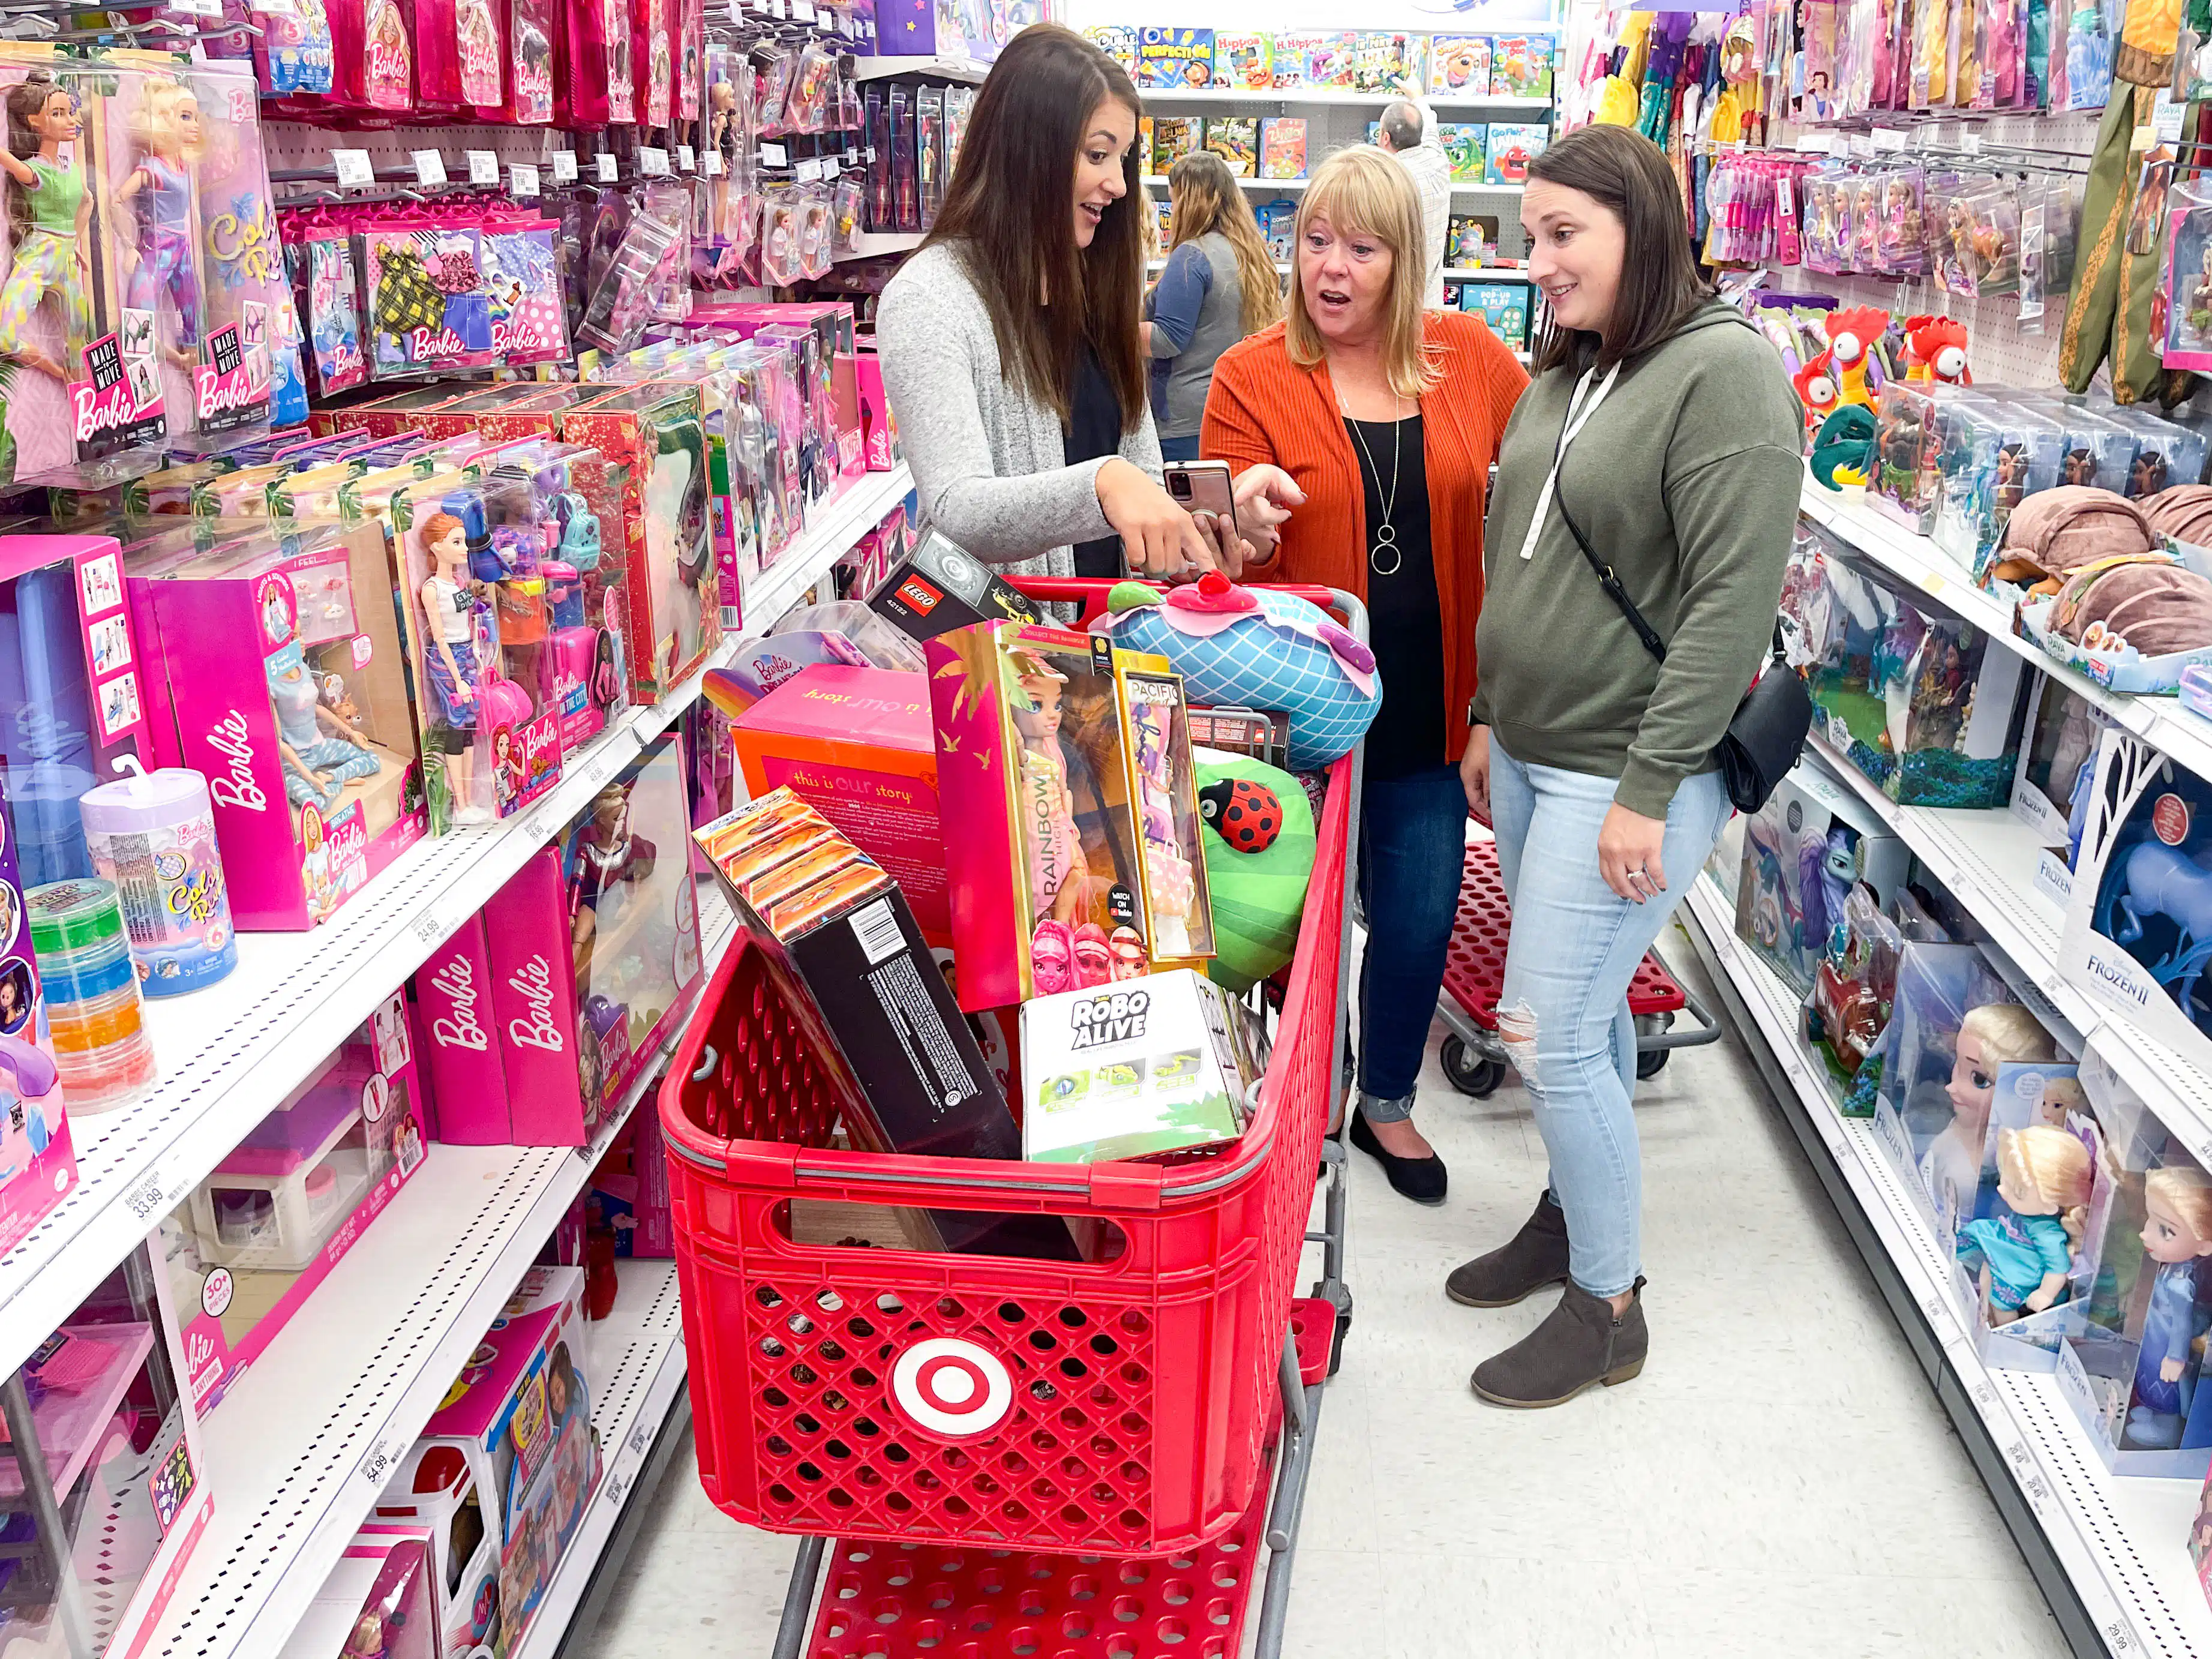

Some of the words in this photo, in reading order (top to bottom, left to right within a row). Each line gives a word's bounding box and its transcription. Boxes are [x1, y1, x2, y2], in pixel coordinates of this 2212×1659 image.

[370, 42, 408, 80] Barbie
[467, 41, 497, 74] Barbie
[517, 62, 548, 96] Barbie
[91, 341, 116, 366] MADE
[214, 331, 236, 352] MADE
[413, 328, 464, 359] Barbie
[492, 324, 539, 355] Barbie
[220, 352, 241, 373] MOVE
[97, 367, 121, 390] MOVE
[199, 371, 252, 419] Barbie
[74, 385, 137, 442] Barbie
[871, 428, 887, 468] Barbie
[887, 599, 908, 616] 42122
[902, 584, 937, 607] LEGO
[1025, 629, 1048, 638] COLLECT
[270, 661, 278, 676] 5
[752, 653, 792, 680] Barbie
[554, 671, 578, 701] Barbie
[802, 689, 853, 704] story
[559, 703, 566, 714] IN
[566, 698, 575, 710] THE
[526, 719, 557, 760] Barbie
[211, 709, 267, 812] Barbie
[794, 770, 820, 787] this
[824, 775, 834, 790] is
[331, 804, 355, 827] BREATHE
[2019, 791, 2042, 816] FROZEN
[178, 820, 210, 845] Barbie
[329, 823, 366, 872] Barbie
[1033, 775, 1058, 896] RAINBOW
[2040, 862, 2072, 894] FROZEN
[1112, 892, 1130, 901] WATCH
[418, 919, 440, 943] 24.99
[2087, 955, 2139, 997] FROZEN
[2138, 988, 2150, 1006] II
[431, 954, 488, 1051] Barbie
[509, 954, 563, 1052] Barbie
[1072, 991, 1150, 1028] ROBO
[1073, 1014, 1146, 1050] ALIVE
[601, 1030, 628, 1080] Barbie
[1875, 1110, 1904, 1163] FROZEN
[141, 1171, 160, 1190] CAREER
[133, 1188, 163, 1218] 33.99
[206, 1274, 227, 1299] 30+
[209, 1286, 230, 1311] PIECES
[196, 1363, 220, 1394] ANYTHING
[2061, 1353, 2087, 1397] FROZEN
[367, 1455, 387, 1482] 54.99
[2108, 1624, 2127, 1649] 29.99
